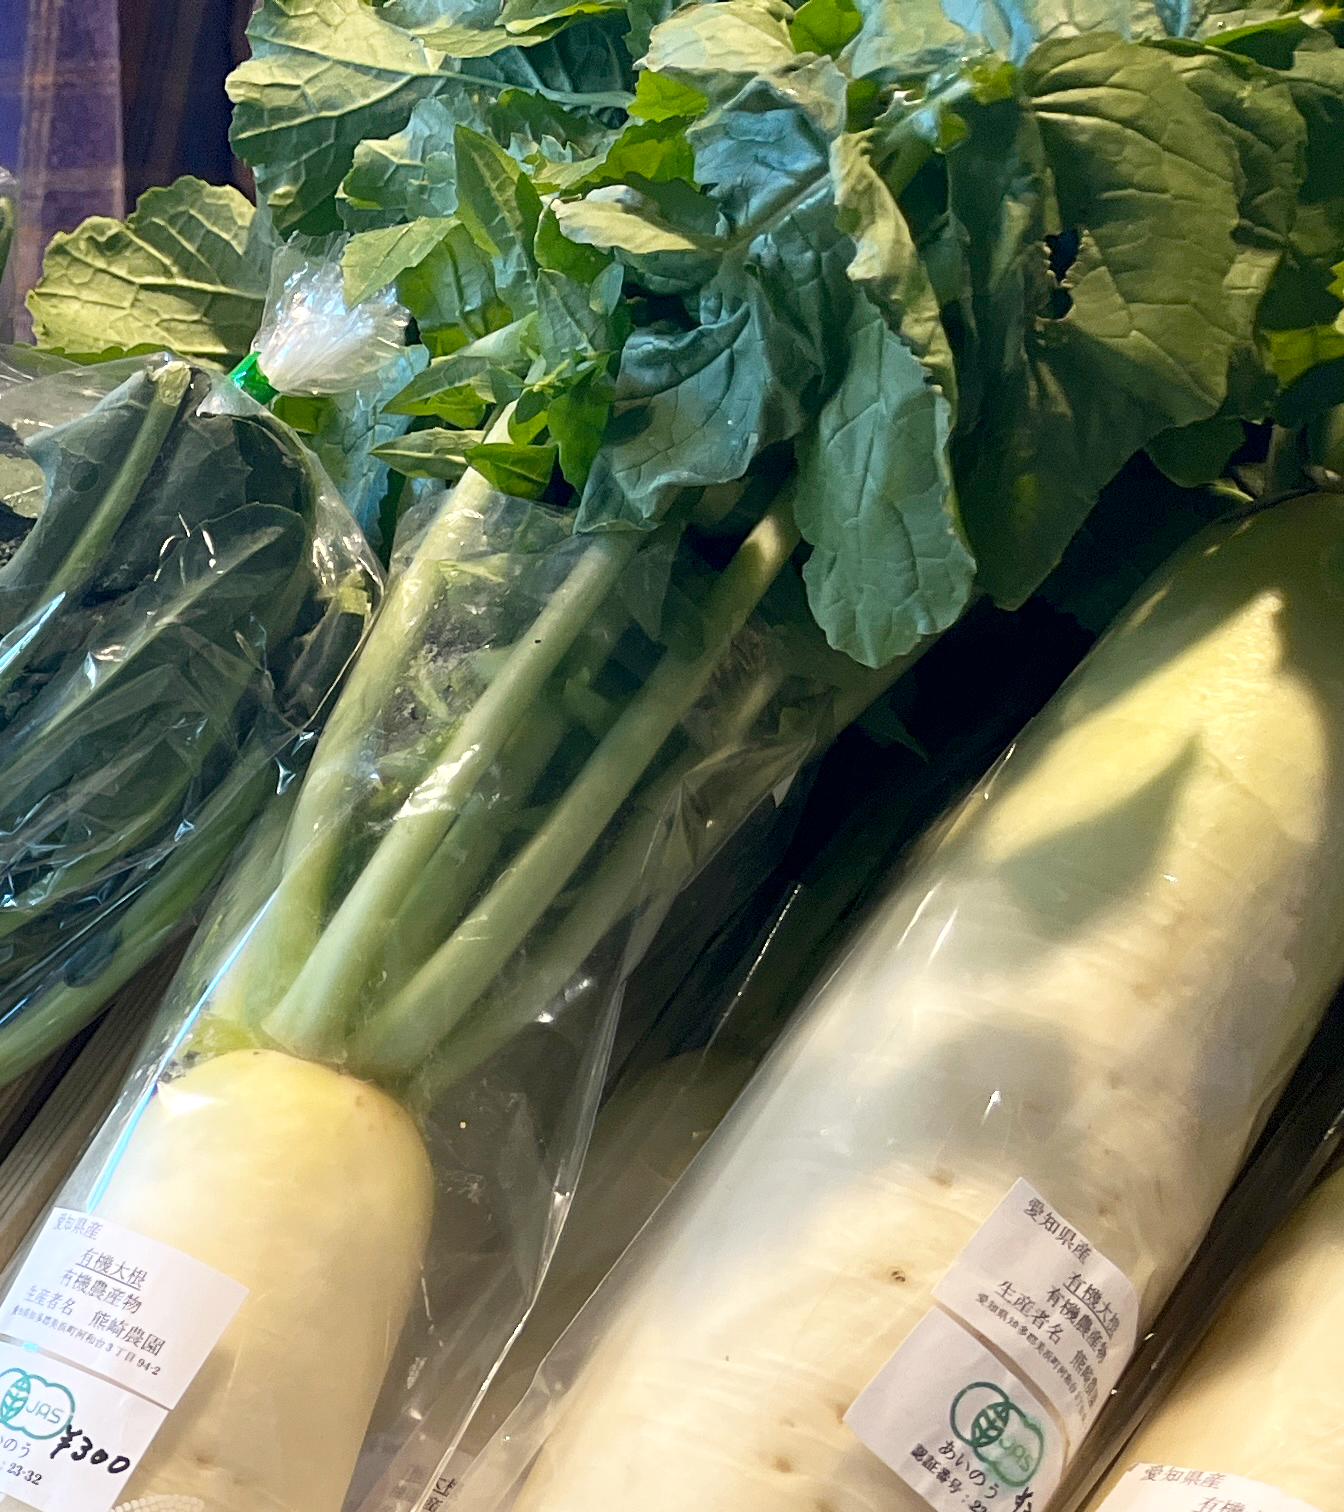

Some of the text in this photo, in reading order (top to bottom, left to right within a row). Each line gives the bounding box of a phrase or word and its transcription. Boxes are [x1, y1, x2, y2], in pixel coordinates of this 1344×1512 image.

[1023, 1196, 1093, 1266] 愛知県産
[59, 1267, 144, 1316] 有機農産物
[78, 1247, 149, 1290] 有機大根
[22, 1283, 167, 1358] 生産者名 熊崎農園
[994, 1279, 1065, 1346] 生産者名
[25, 1400, 65, 1425] JAS
[49, 1424, 132, 1474] ¥300
[937, 1439, 1001, 1500] あいのう
[1139, 1464, 1227, 1490] 愛知県産
